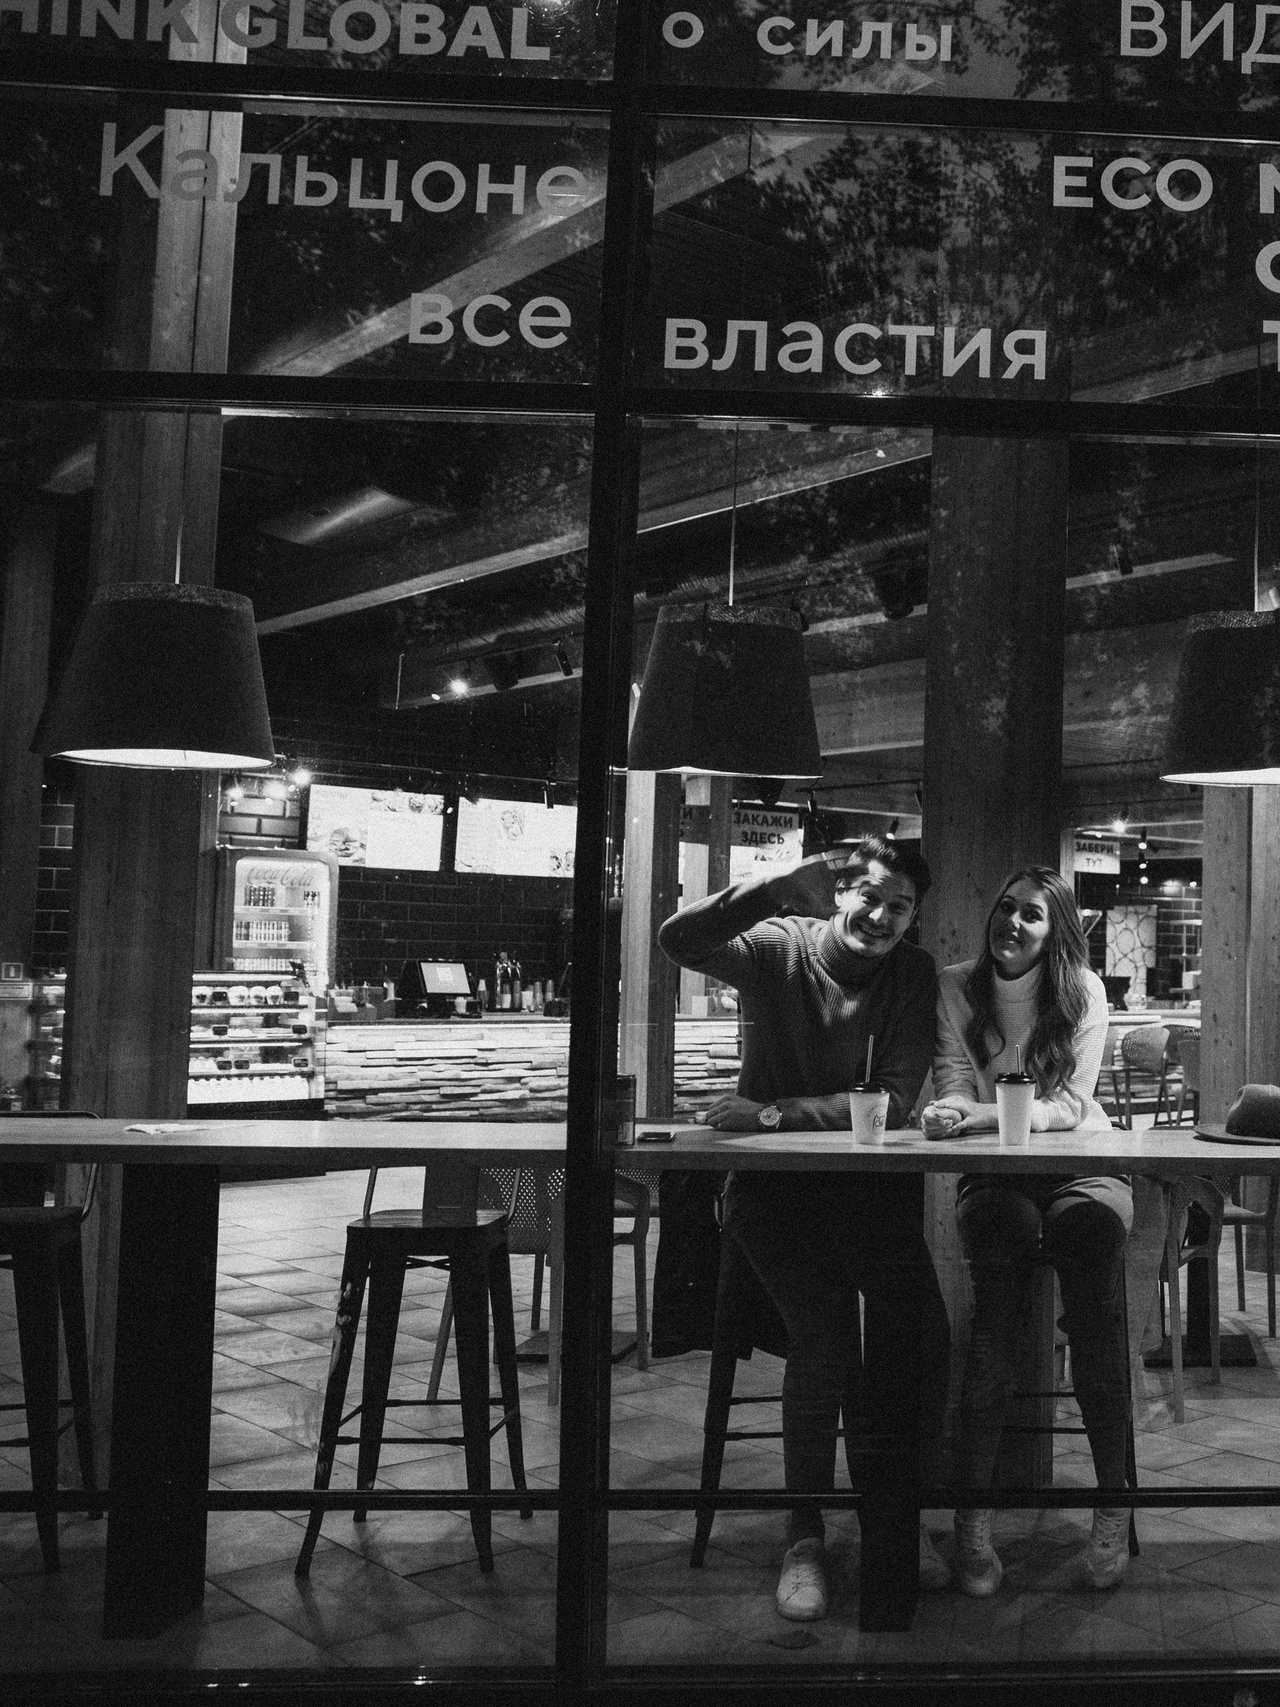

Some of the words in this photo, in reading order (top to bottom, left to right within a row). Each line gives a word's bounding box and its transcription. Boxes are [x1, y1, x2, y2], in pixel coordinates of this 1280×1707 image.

[220, 0, 550, 60] GLOBAL
[99, 122, 588, 222] Кальцоне
[1053, 156, 1213, 212] ECO
[733, 812, 794, 829] ЗАКАЖИ
[741, 831, 785, 845] ЗДЕСЬ
[1075, 841, 1114, 854] ЗАБЕРИ
[1086, 857, 1102, 867] ТУТ
